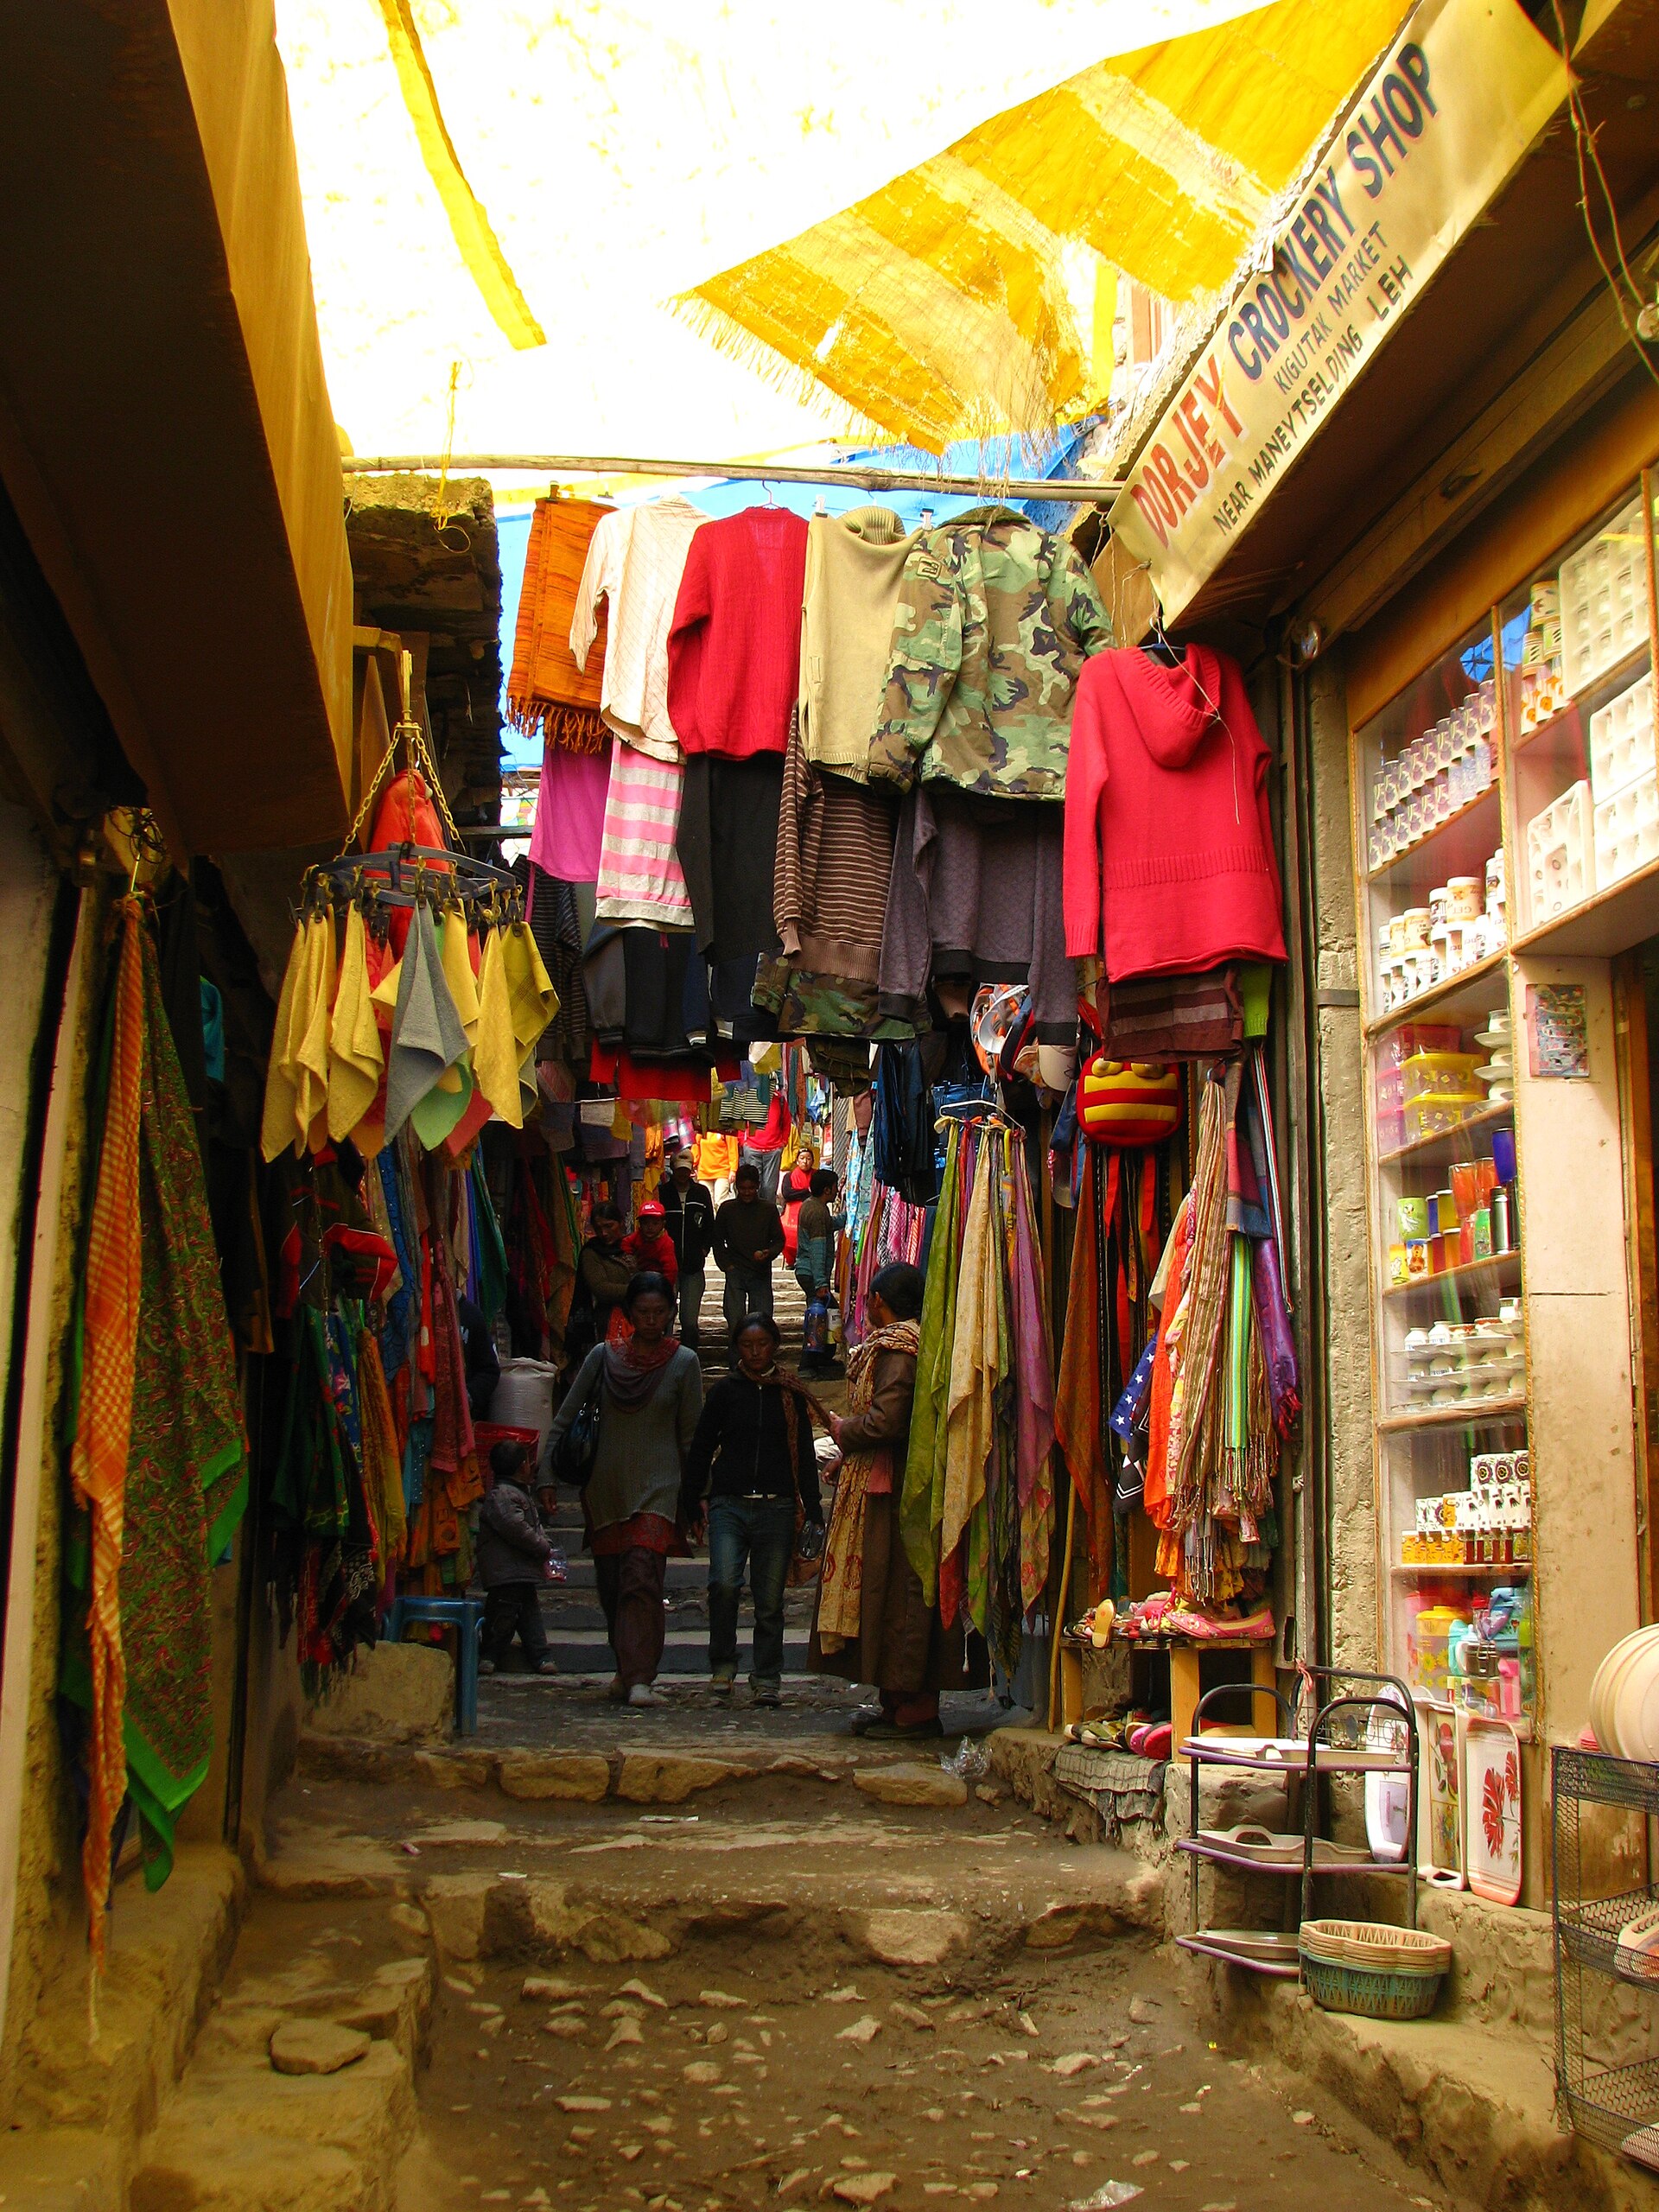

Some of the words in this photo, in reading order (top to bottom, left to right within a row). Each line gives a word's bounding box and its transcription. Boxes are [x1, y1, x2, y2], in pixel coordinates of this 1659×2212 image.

[1130, 353, 1243, 549] DORJEY
[1228, 166, 1357, 380] CROCKERY
[1346, 42, 1438, 199] SHOP
[1213, 481, 1254, 535] NEAR
[1367, 254, 1414, 321] LEH
[1274, 312, 1332, 395] KIGUTAK
[1327, 220, 1389, 318] MARKET
